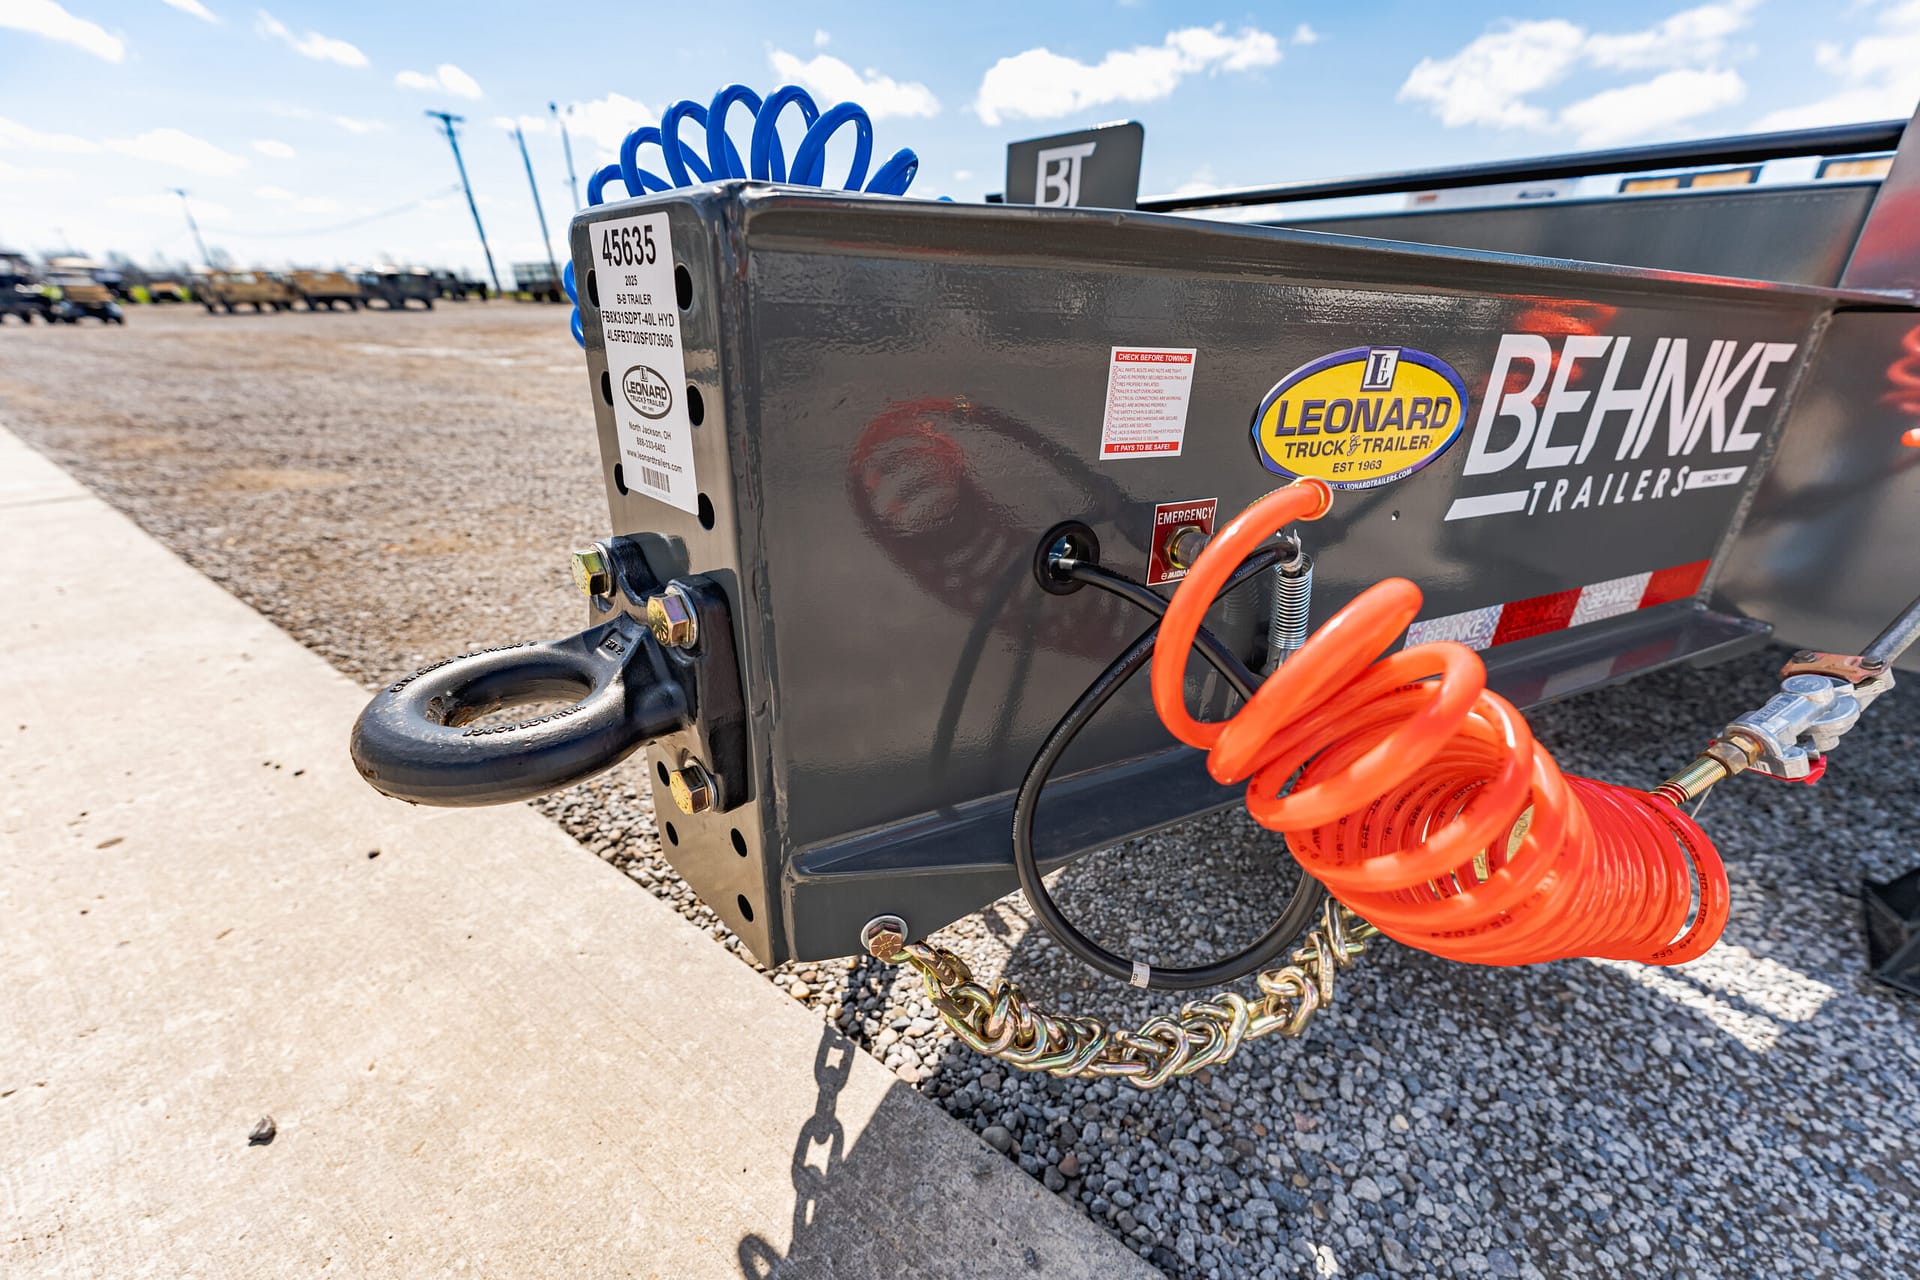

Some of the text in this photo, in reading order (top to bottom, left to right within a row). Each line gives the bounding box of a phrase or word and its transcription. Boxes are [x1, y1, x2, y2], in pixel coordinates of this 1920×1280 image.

[1035, 142, 1096, 207] BT
[602, 224, 656, 267] 45635
[624, 275, 638, 287] 2025
[627, 293, 652, 305] TRAILER
[658, 312, 675, 327] HYD
[1118, 353, 1139, 361] CHECK
[626, 380, 667, 400] LEONARD
[1462, 334, 1797, 476] BEHNKE
[1274, 396, 1453, 437] LEONARD
[1284, 439, 1347, 459] TRUCK
[1363, 435, 1428, 454] TRAILER
[1332, 460, 1382, 473] EST 1963
[1344, 469, 1412, 490] LEONARDTRAILERS.COM
[1528, 466, 1690, 516] TRAILERS
[1157, 506, 1215, 525] EMERGENCY
